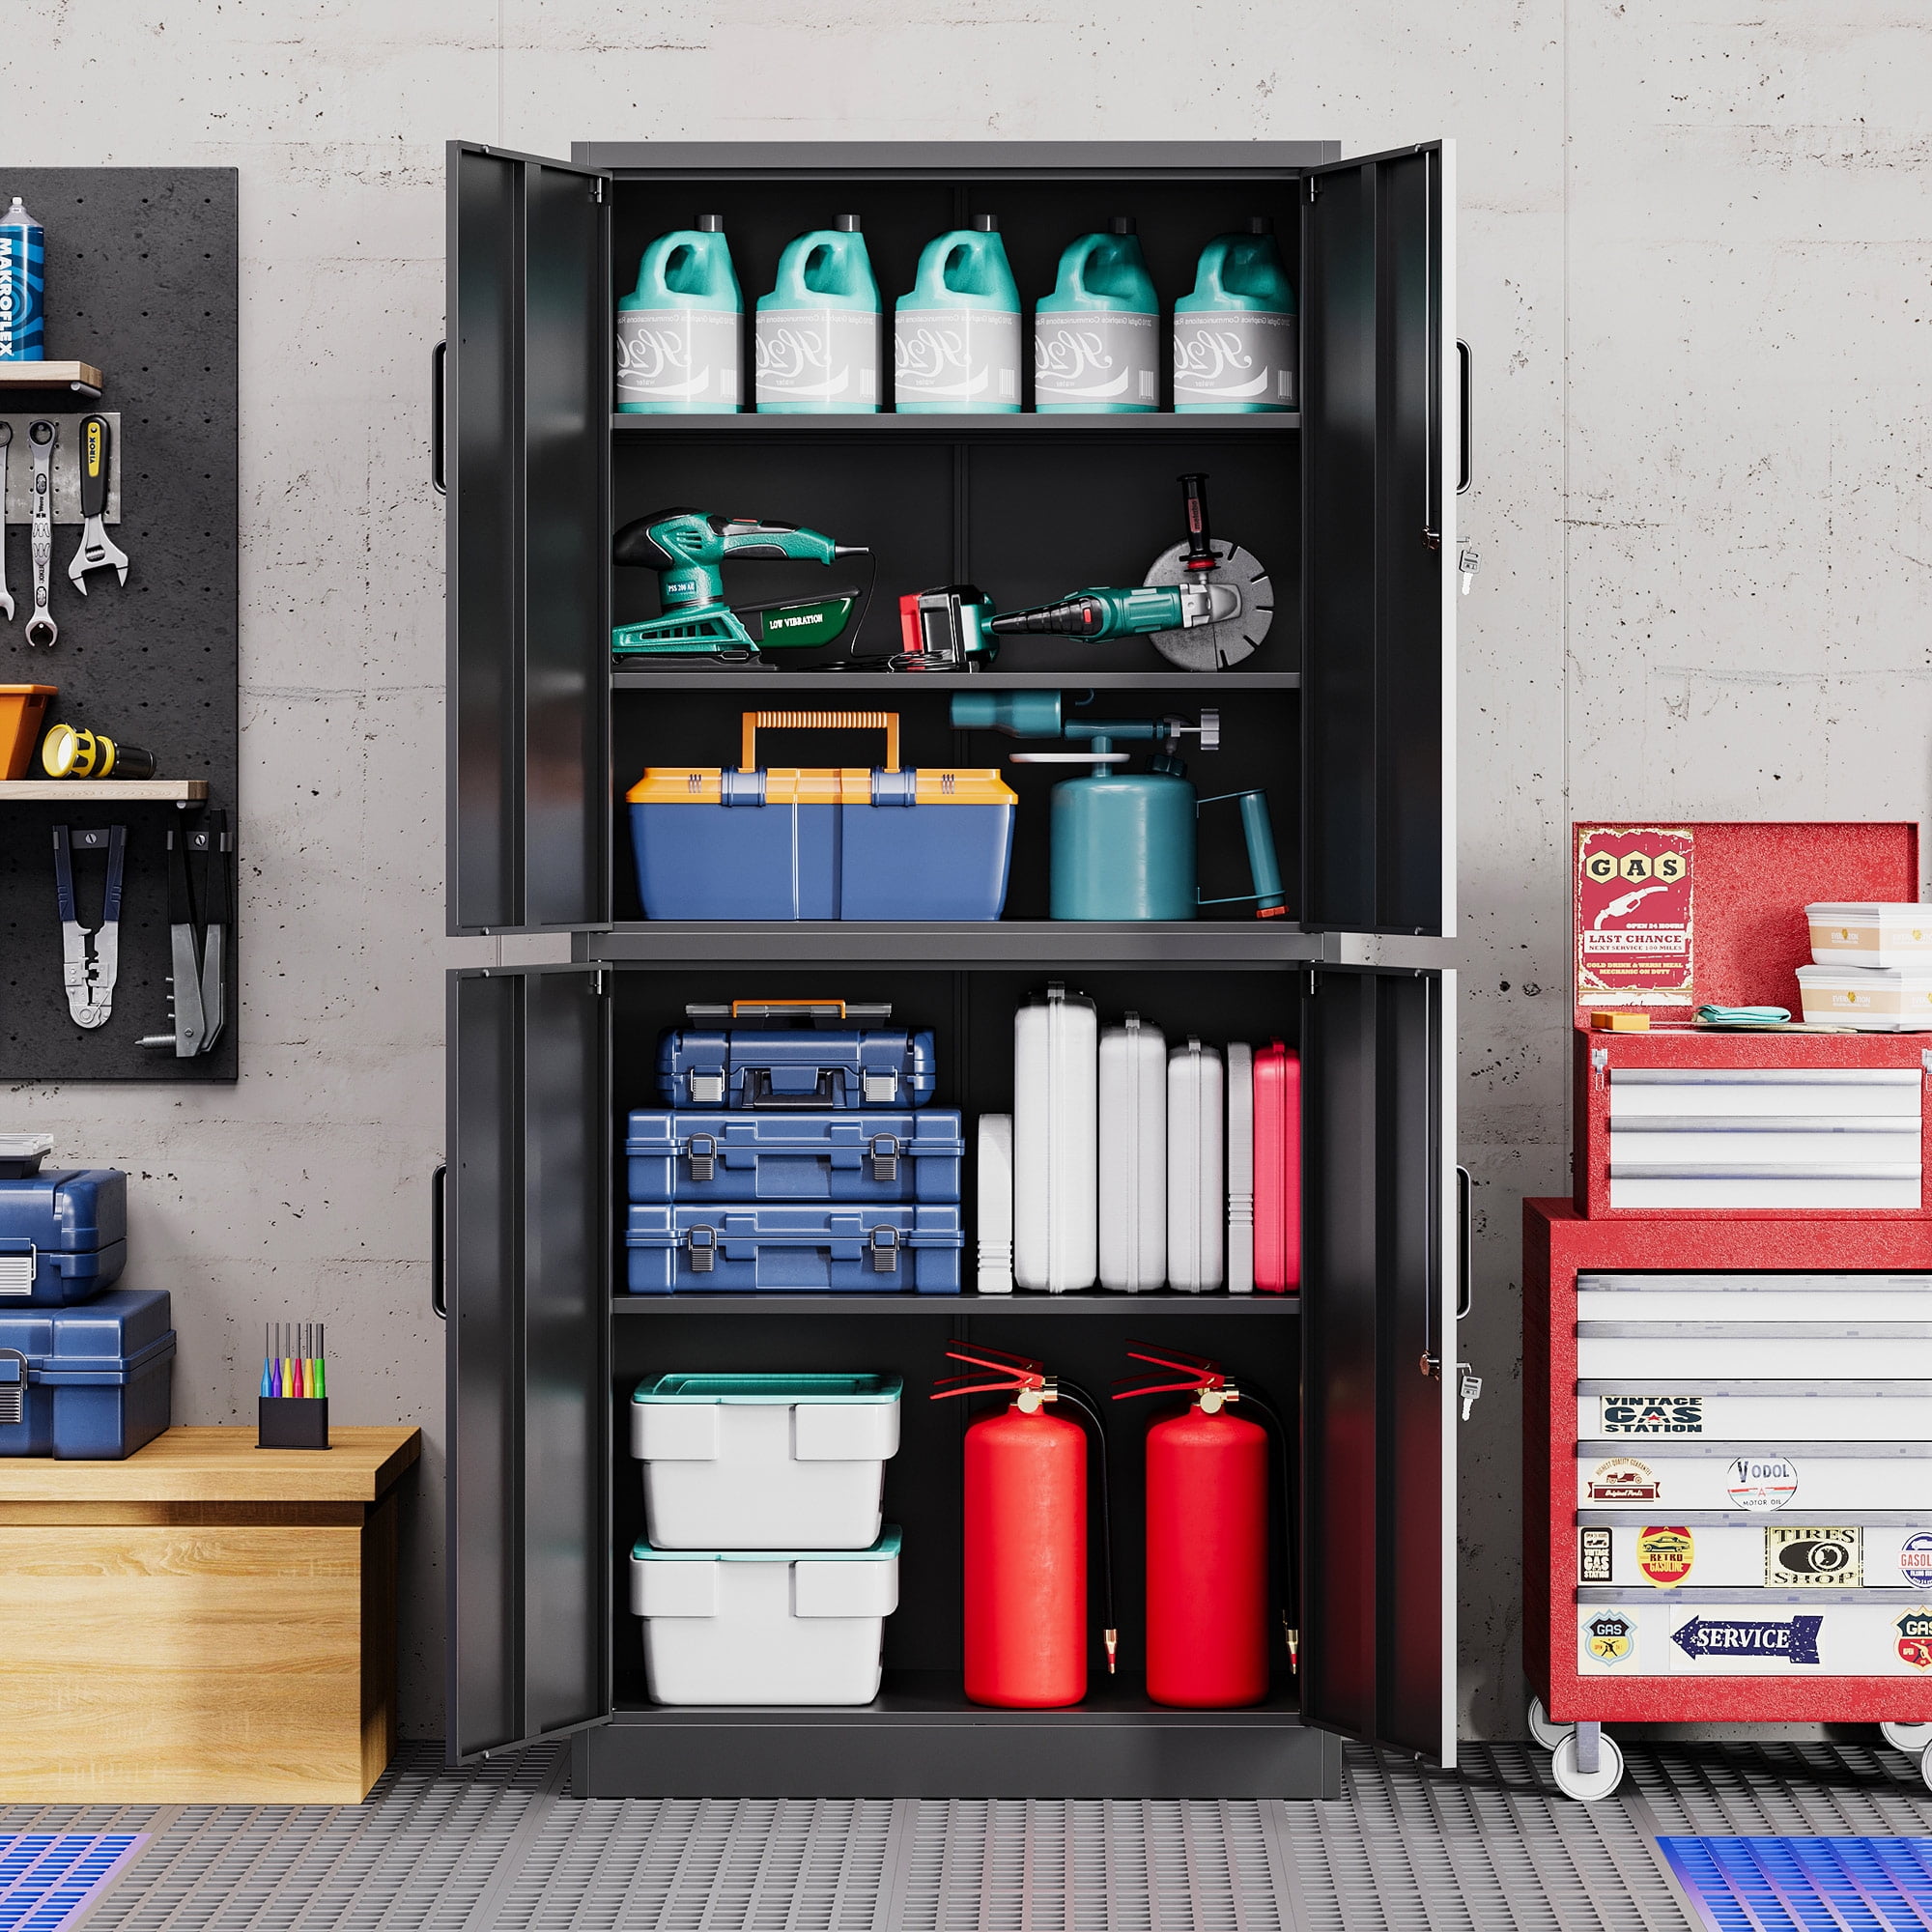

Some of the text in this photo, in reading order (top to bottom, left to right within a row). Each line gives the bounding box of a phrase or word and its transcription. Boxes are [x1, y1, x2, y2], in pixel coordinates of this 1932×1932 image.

[0, 238, 13, 356] MAKROFLEX
[769, 613, 823, 630] LOW VIBRATION
[1591, 859, 1677, 876] GAS
[1605, 1397, 1702, 1406] VINTAGE
[1605, 1406, 1702, 1423] GAS
[1605, 1424, 1702, 1433] STATION
[1611, 1458, 1629, 1466] QUALITY
[1737, 1461, 1789, 1483] VODOL
[1775, 1529, 1855, 1544] TIRES
[1584, 1555, 1609, 1571] GAS
[1649, 1562, 1684, 1573] GASOLINE
[1775, 1572, 1855, 1584] SHOP
[1597, 1624, 1622, 1634] GAS
[1696, 1628, 1790, 1648] SERVICE
